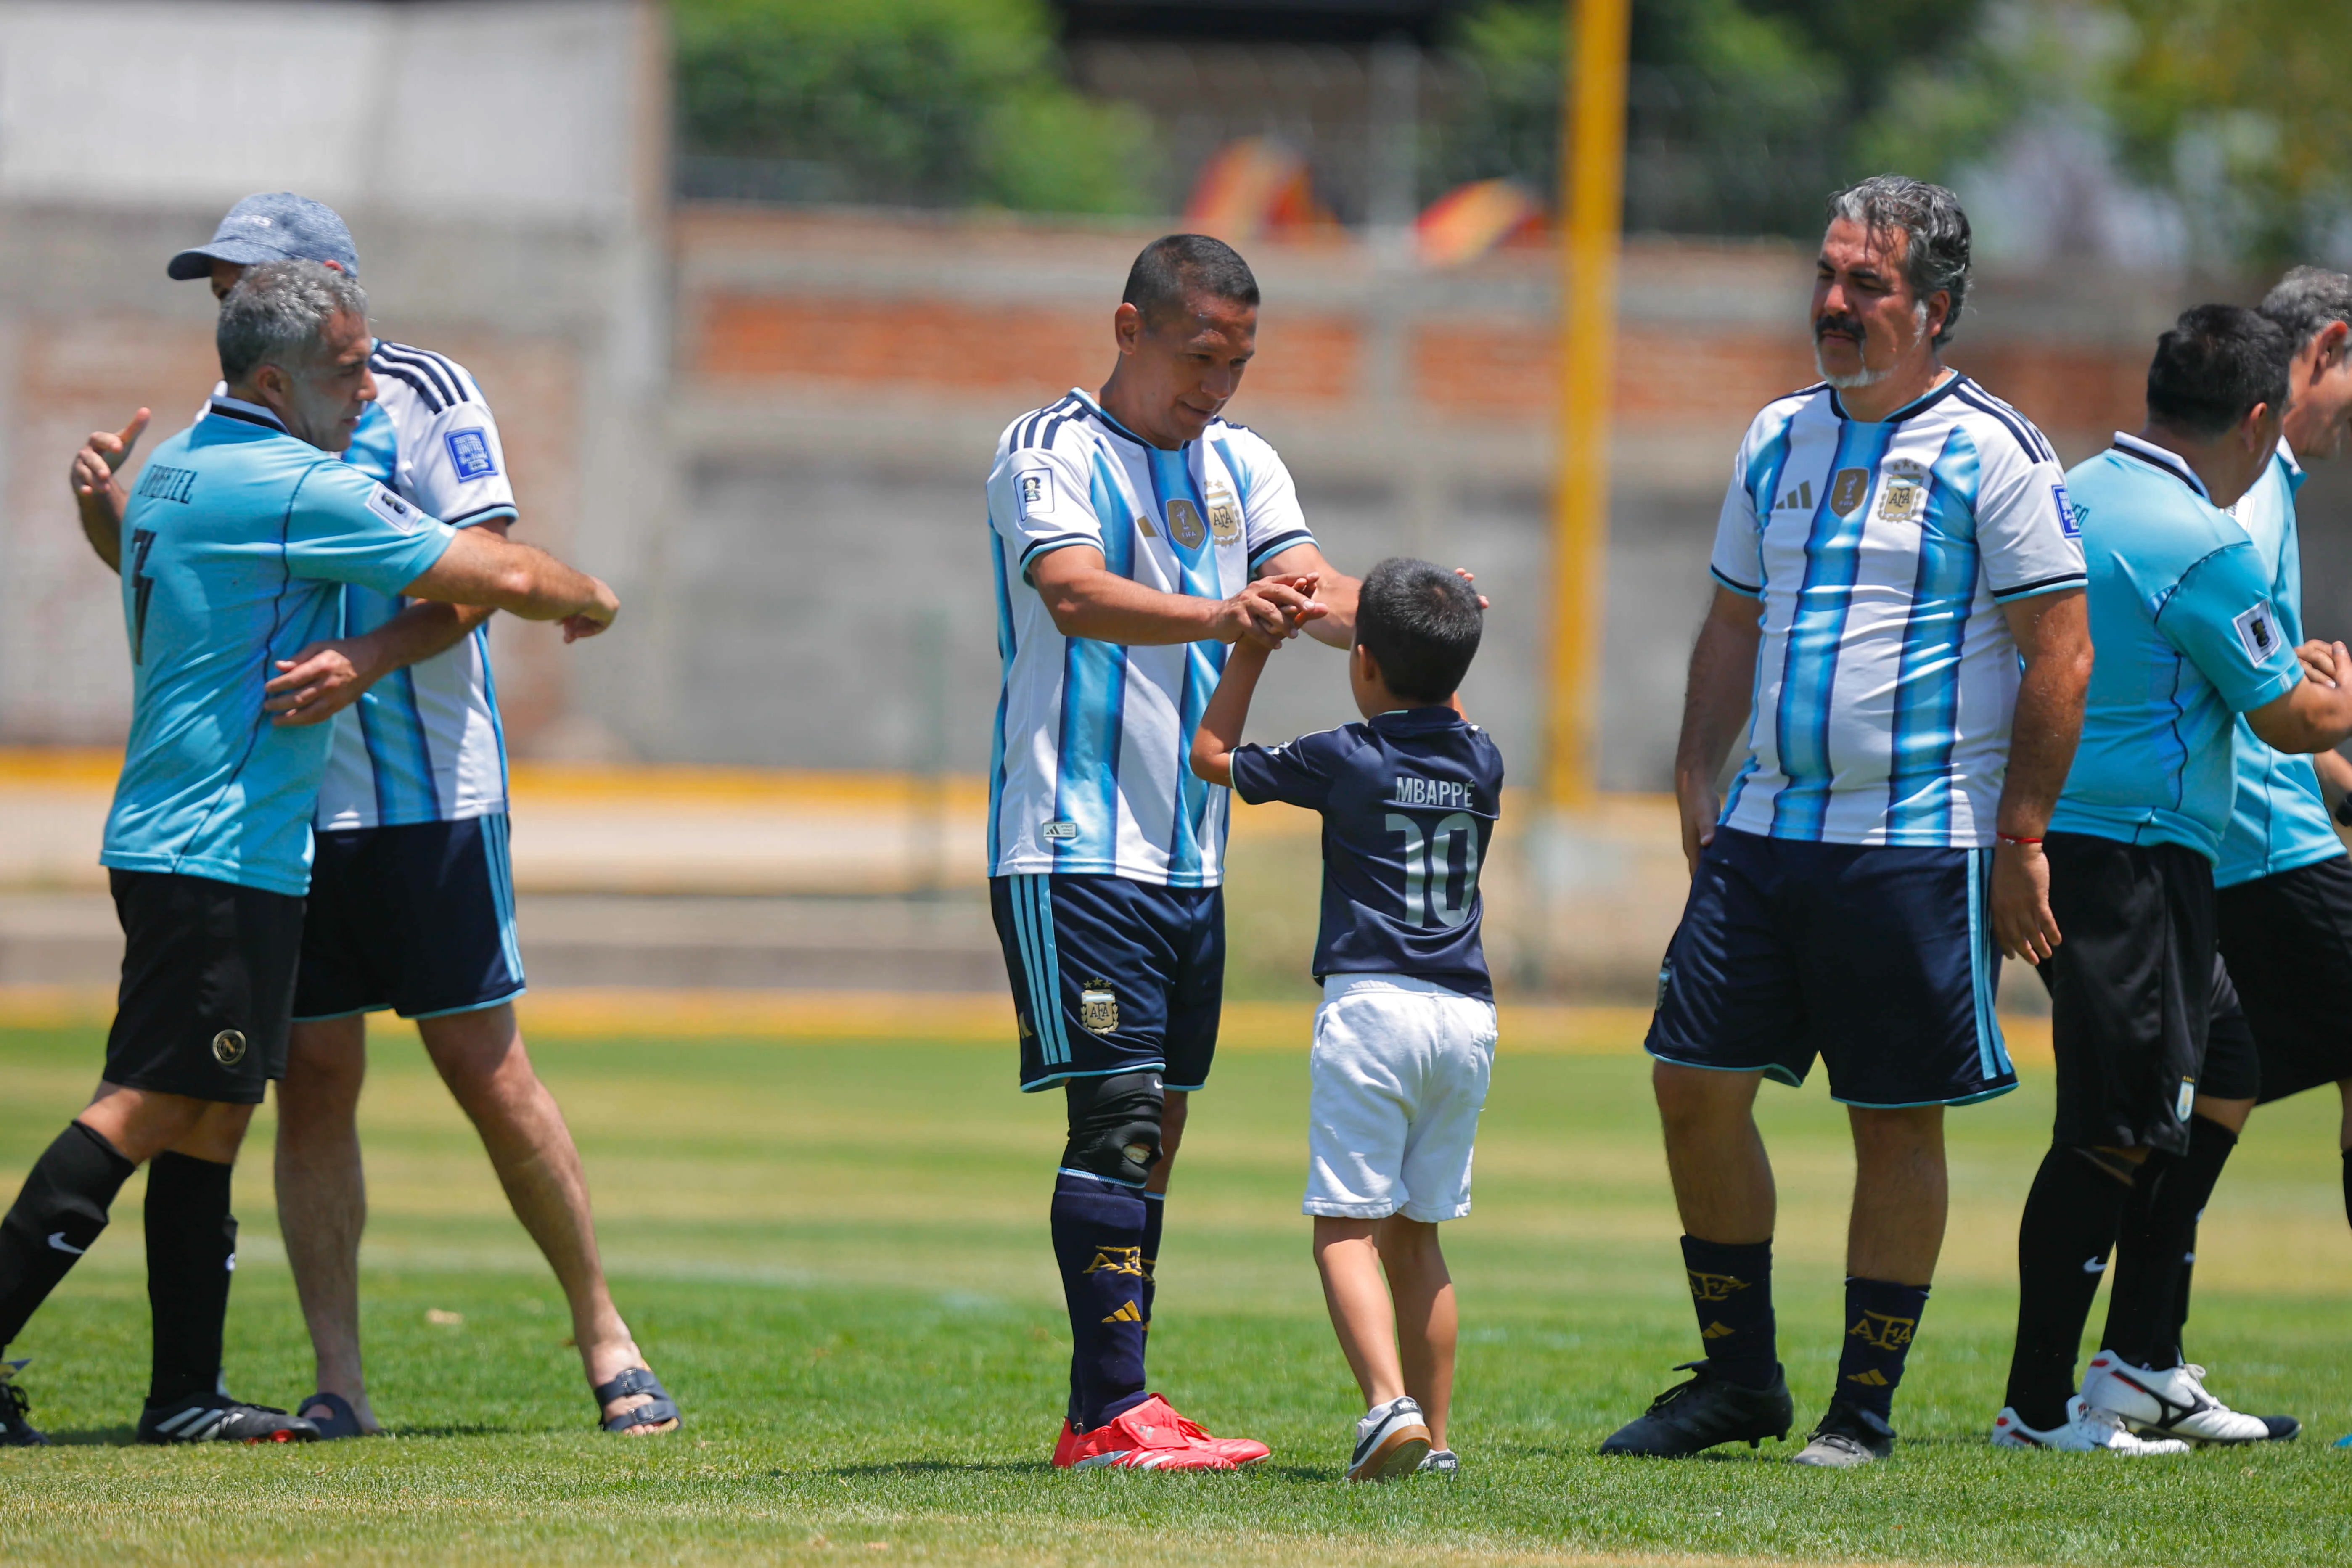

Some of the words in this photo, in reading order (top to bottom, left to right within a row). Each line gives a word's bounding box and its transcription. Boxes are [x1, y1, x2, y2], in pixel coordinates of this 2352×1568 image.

[1889, 487, 1910, 508] AFA
[1211, 505, 1233, 529] AFA
[1395, 777, 1475, 807] MBAPPÉ
[1385, 812, 1478, 928] 10
[1090, 1001, 1110, 1021] AFA
[1848, 1309, 1915, 1351] AFA
[1397, 1401, 1418, 1410] NIKE
[1438, 1459, 1456, 1468] NIKE
